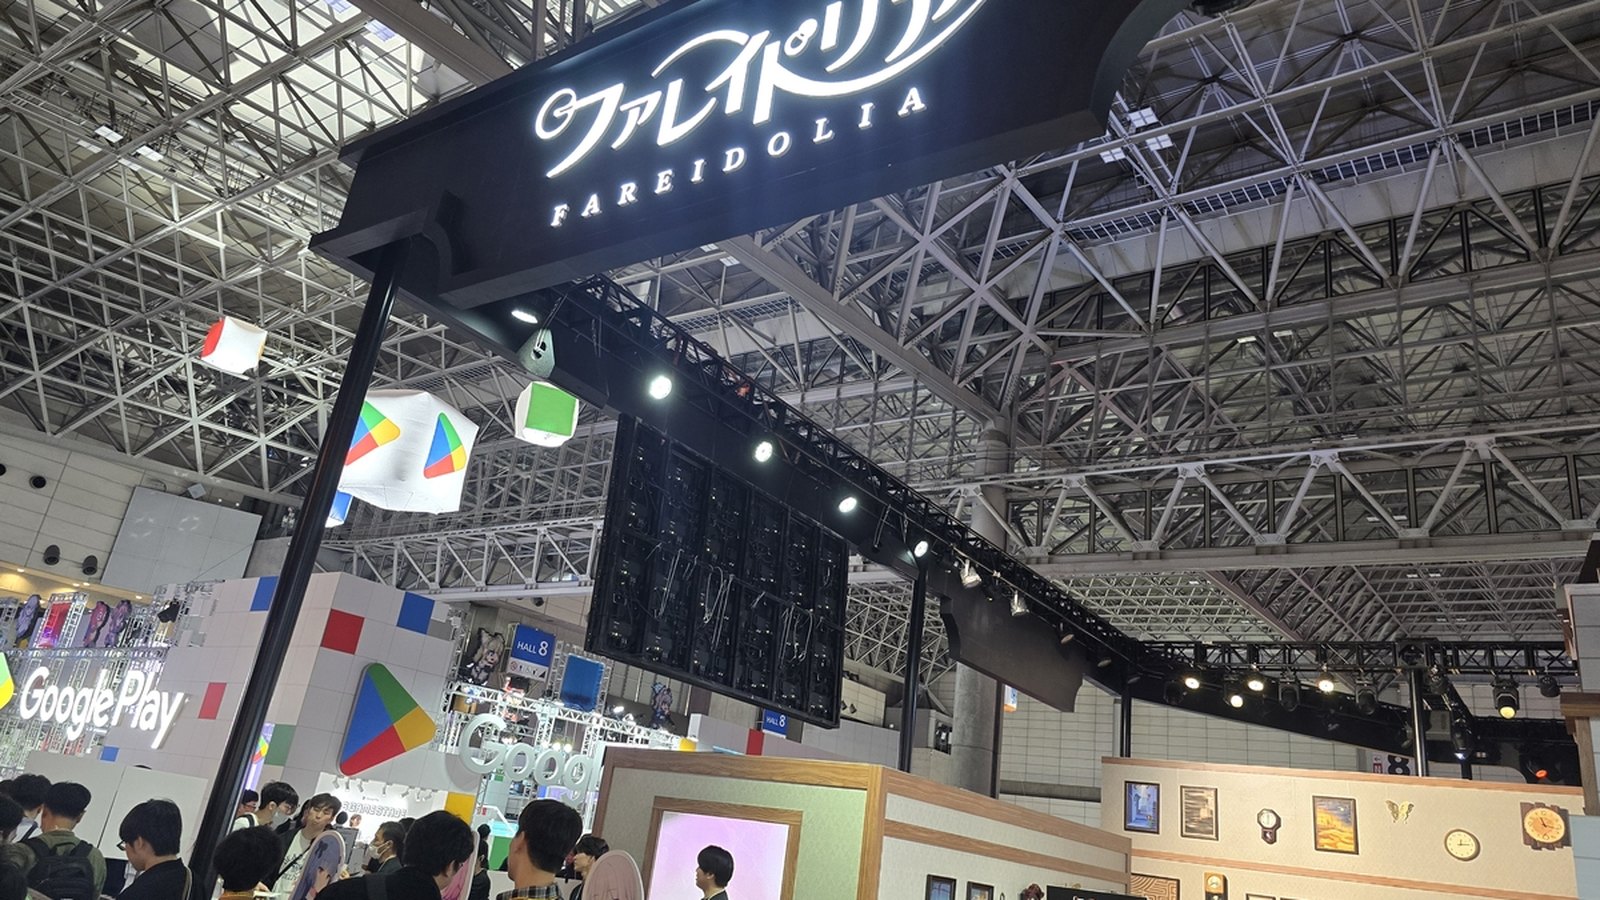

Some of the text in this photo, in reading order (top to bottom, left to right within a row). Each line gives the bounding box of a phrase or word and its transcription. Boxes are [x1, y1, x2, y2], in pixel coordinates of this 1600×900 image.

[550, 86, 927, 228] FAREIDOLIA
[517, 640, 549, 657] HALL 8
[19, 666, 184, 749] Google Play
[766, 714, 786, 728] HALL 8
